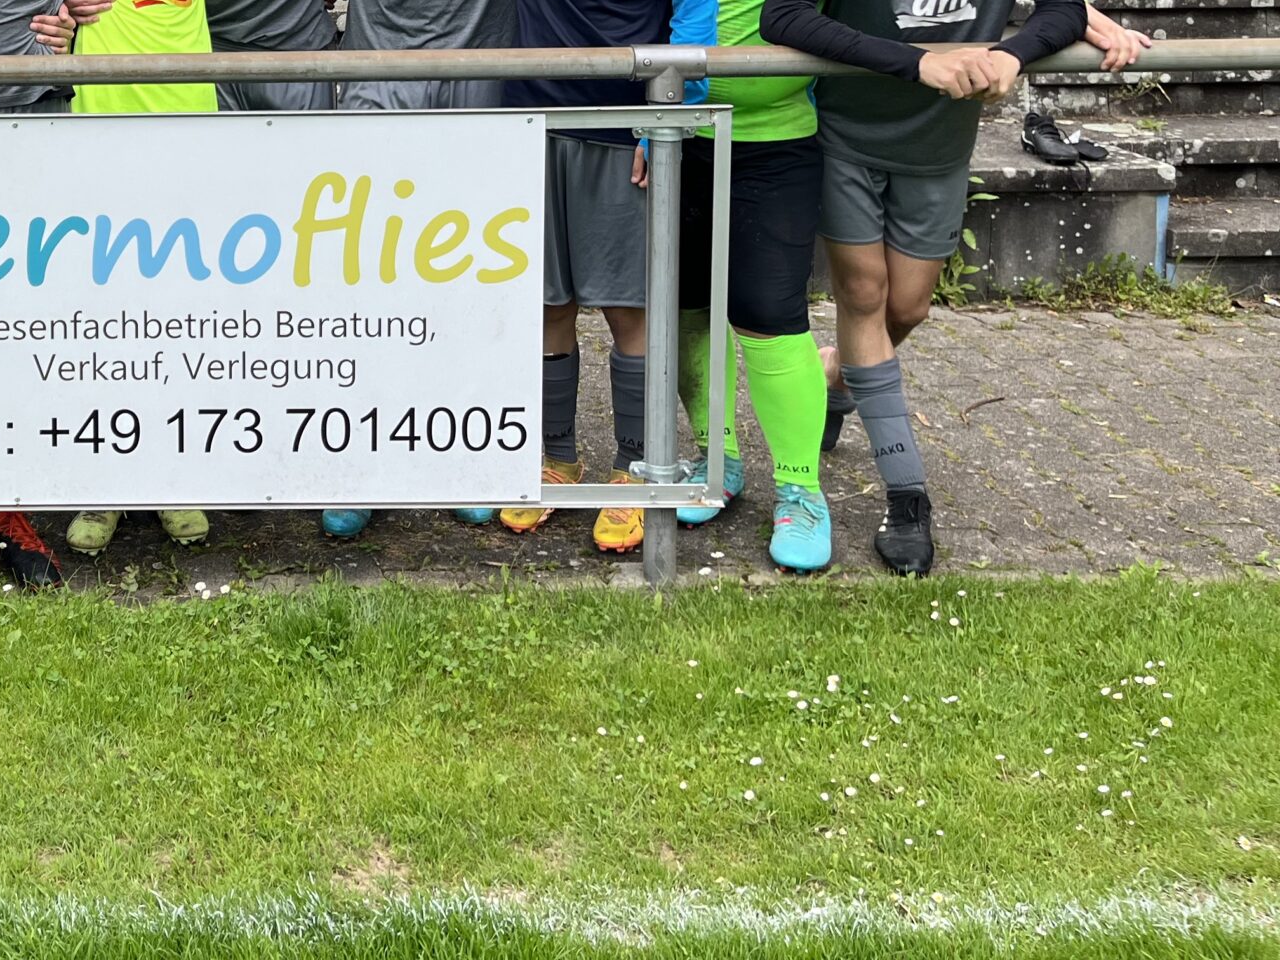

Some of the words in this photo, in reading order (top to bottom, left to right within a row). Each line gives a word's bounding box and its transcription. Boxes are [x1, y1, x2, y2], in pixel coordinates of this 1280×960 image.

[276, 310, 436, 346] Beratung,
[32, 350, 169, 385] Verkauf,
[182, 350, 357, 388] Verlegung
[39, 408, 141, 455] +49
[166, 407, 264, 454] 173
[285, 406, 527, 453] 7014005
[776, 462, 810, 473] JAKO
[874, 442, 905, 458] JAKO
